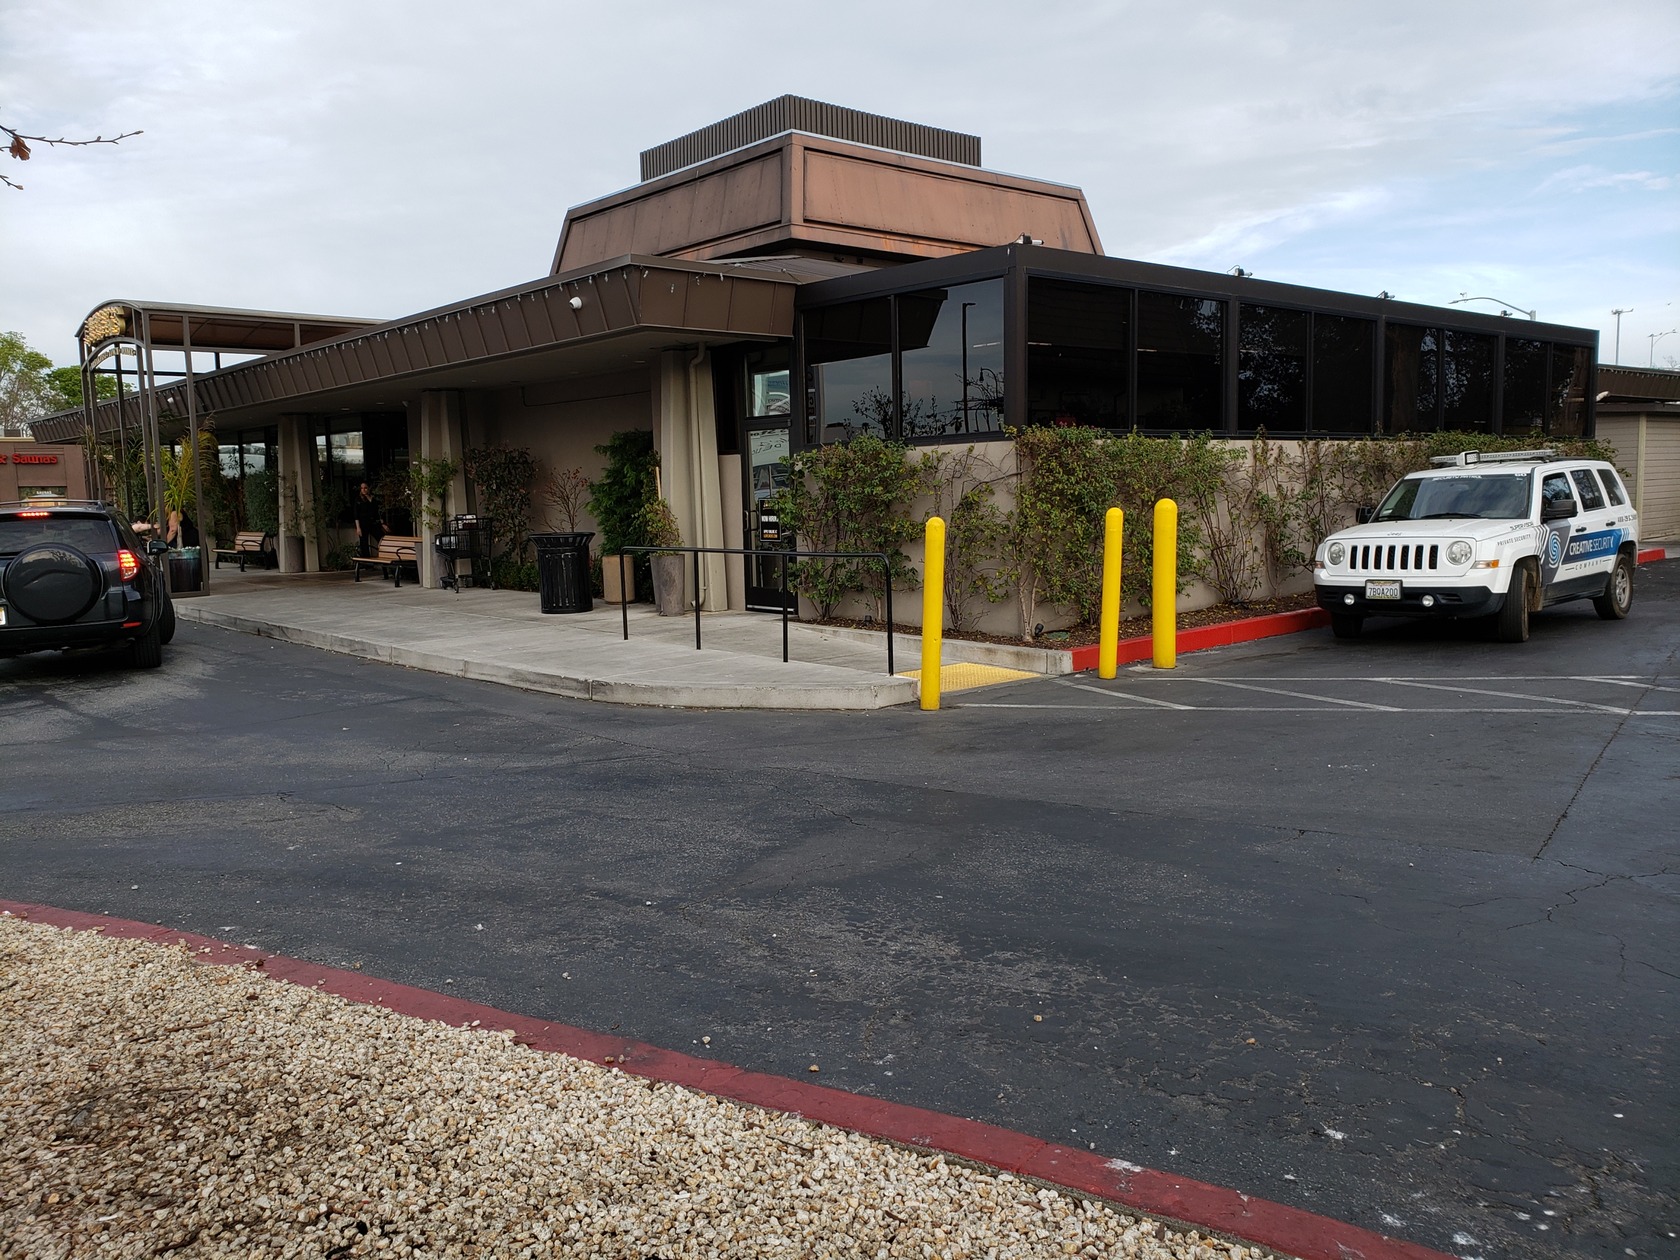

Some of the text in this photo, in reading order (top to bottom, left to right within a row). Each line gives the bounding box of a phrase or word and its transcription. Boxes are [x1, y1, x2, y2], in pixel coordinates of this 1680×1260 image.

[12, 453, 58, 464] Saunas
[1497, 533, 1531, 547] PRIVATE SECURITY
[1575, 559, 1602, 571] COMPANY
